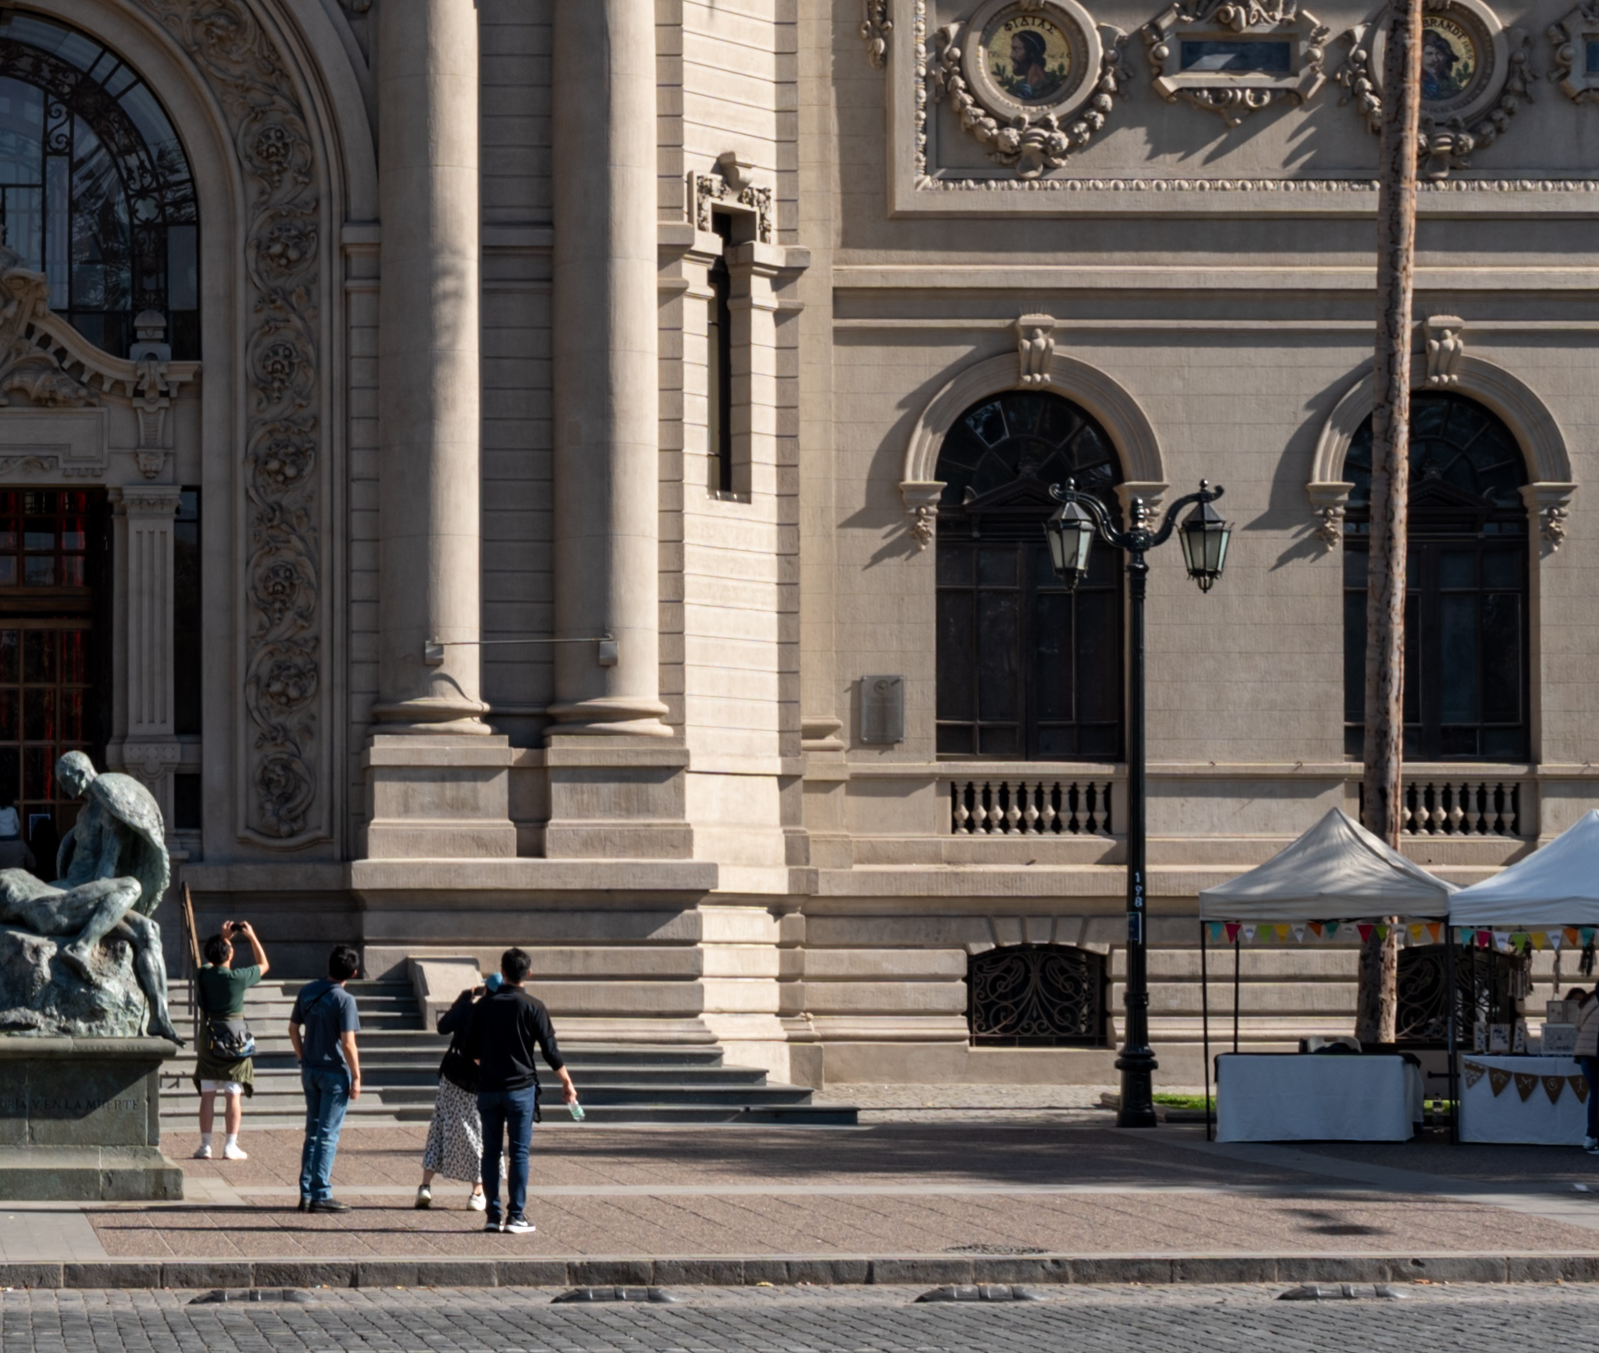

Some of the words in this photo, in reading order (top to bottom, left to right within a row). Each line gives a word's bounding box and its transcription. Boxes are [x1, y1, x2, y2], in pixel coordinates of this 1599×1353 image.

[1134, 872, 1143, 908] 198
[44, 1098, 61, 1110] EN
[65, 1098, 82, 1111] LA
